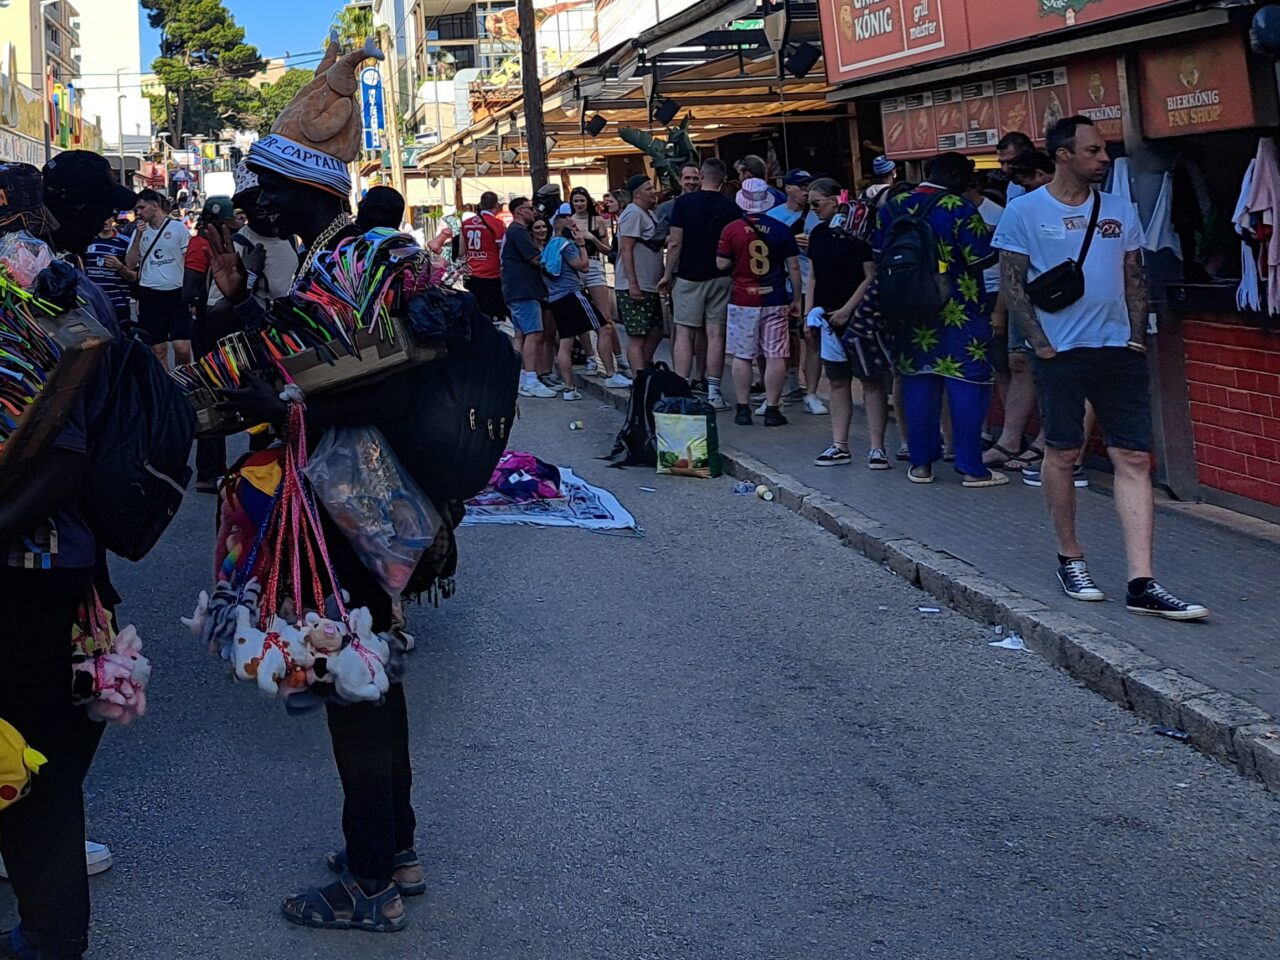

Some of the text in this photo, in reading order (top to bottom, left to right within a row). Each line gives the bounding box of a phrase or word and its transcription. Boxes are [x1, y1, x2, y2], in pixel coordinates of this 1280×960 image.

[854, 6, 893, 42] KÖNIG
[909, 20, 937, 40] meister
[1166, 88, 1220, 111] BIERKÖNIG
[1167, 106, 1221, 127] FAN SHOP
[466, 230, 481, 251] 26
[748, 239, 770, 276] 8
